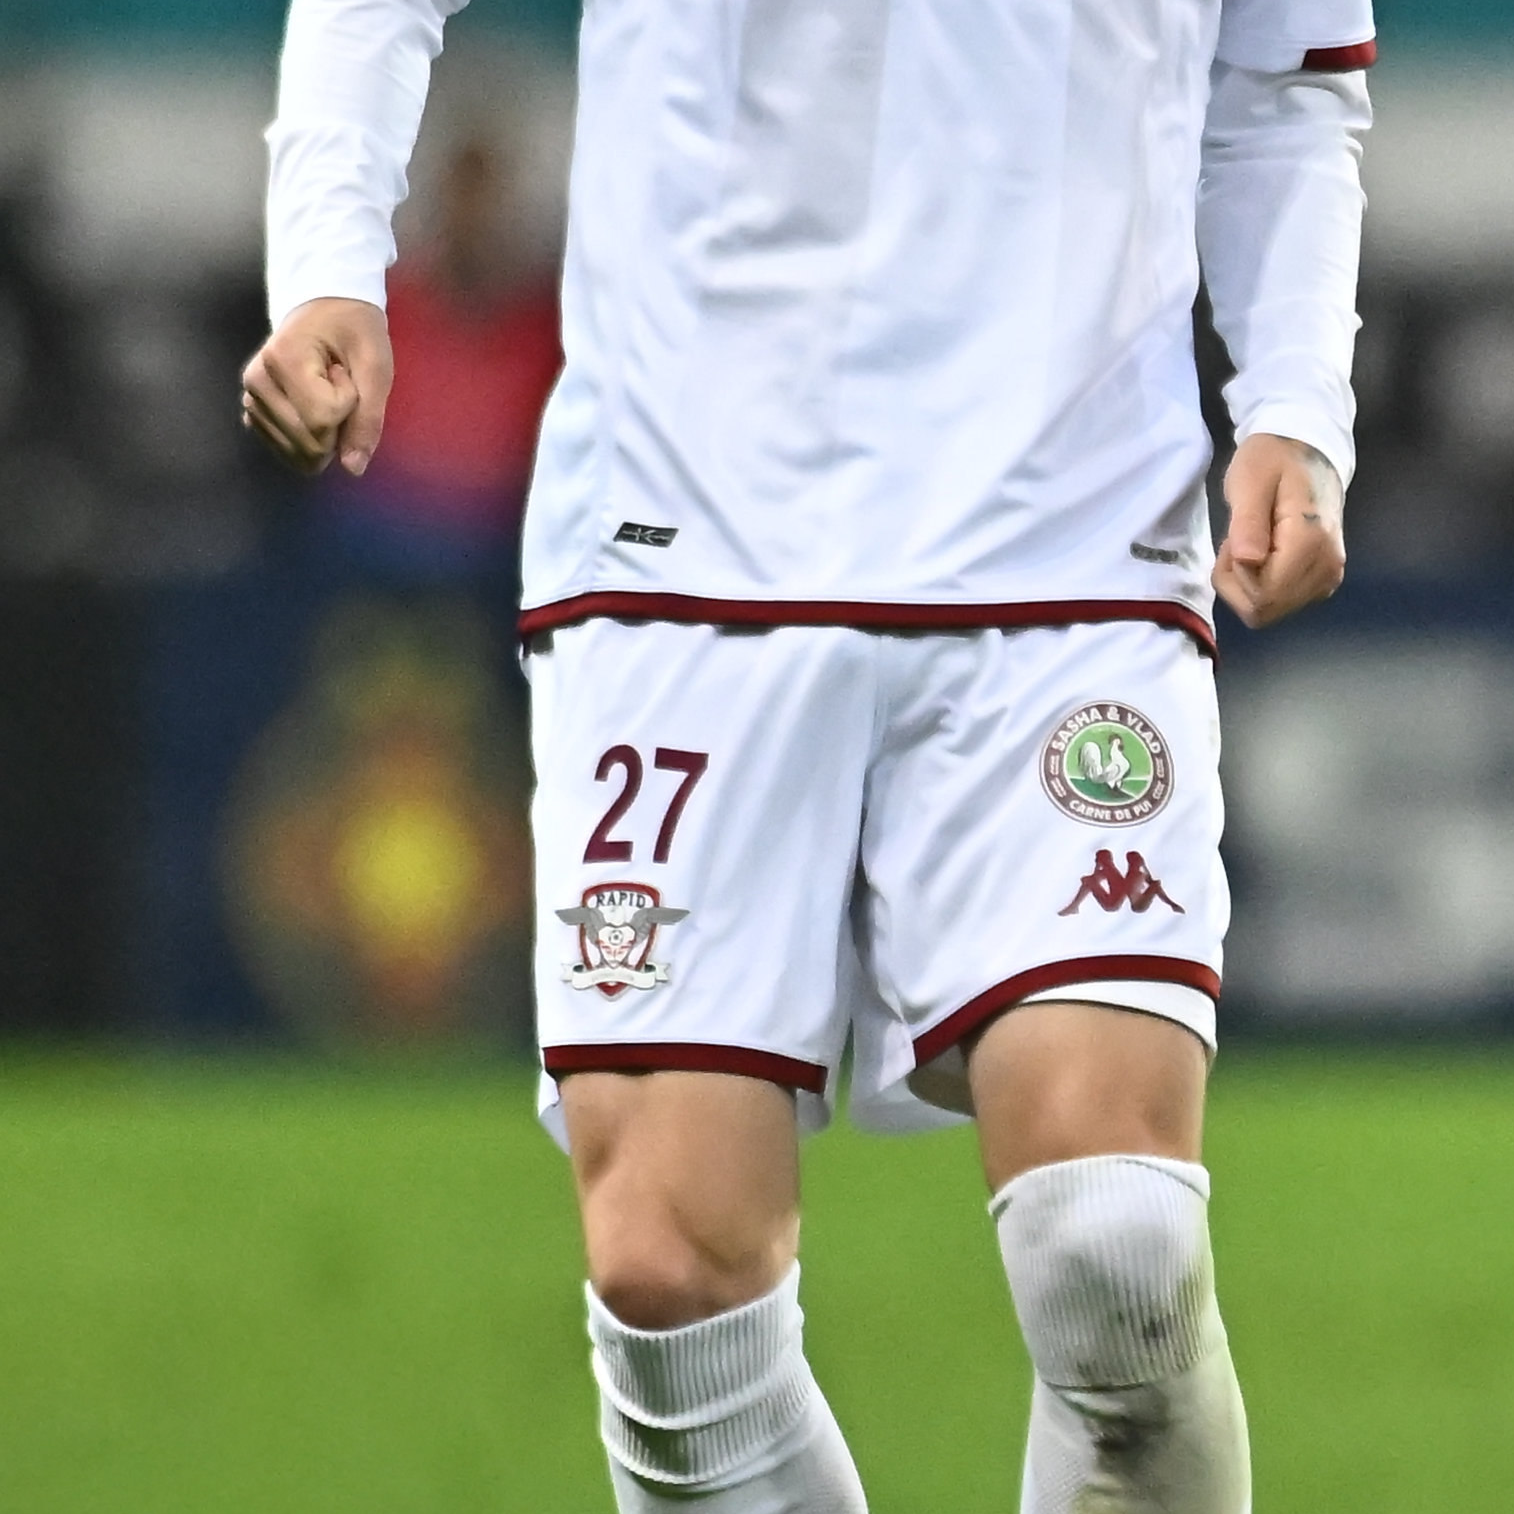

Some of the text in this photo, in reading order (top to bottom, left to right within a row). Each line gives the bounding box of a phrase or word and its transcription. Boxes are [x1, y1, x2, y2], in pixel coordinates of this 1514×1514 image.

[1051, 706, 1162, 754] SASHA & VLAD
[582, 744, 710, 864] 27
[1068, 799, 1153, 822] CARNE DE PUI
[596, 890, 647, 910] RAPID
